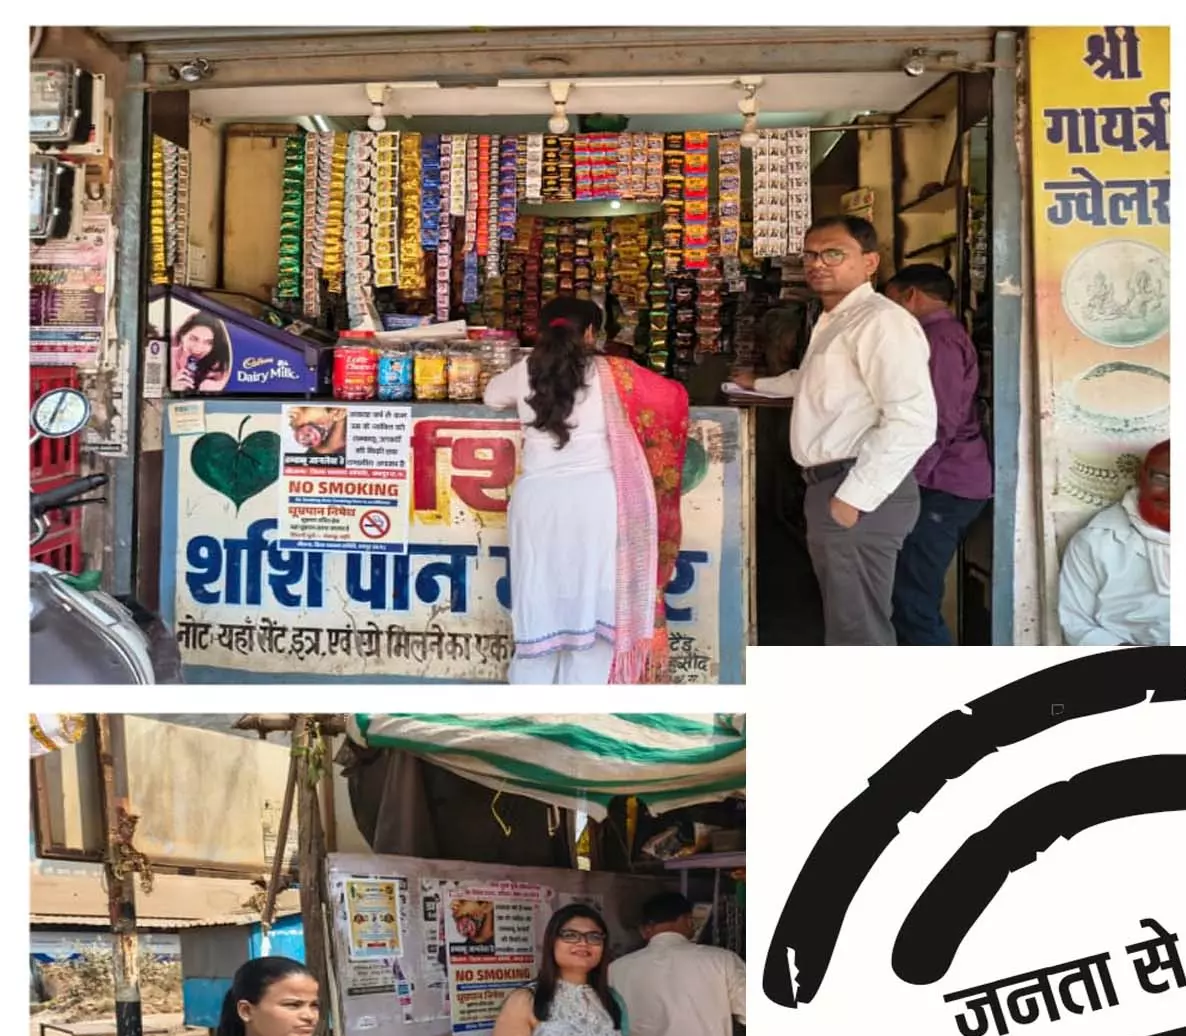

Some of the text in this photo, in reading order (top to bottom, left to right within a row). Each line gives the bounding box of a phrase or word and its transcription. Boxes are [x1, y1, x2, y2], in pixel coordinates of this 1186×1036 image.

[237, 370, 269, 384] Dairy
[289, 481, 399, 497] NO SMOKING
[346, 543, 478, 613] पान
[456, 968, 530, 981] NO SMOKING
